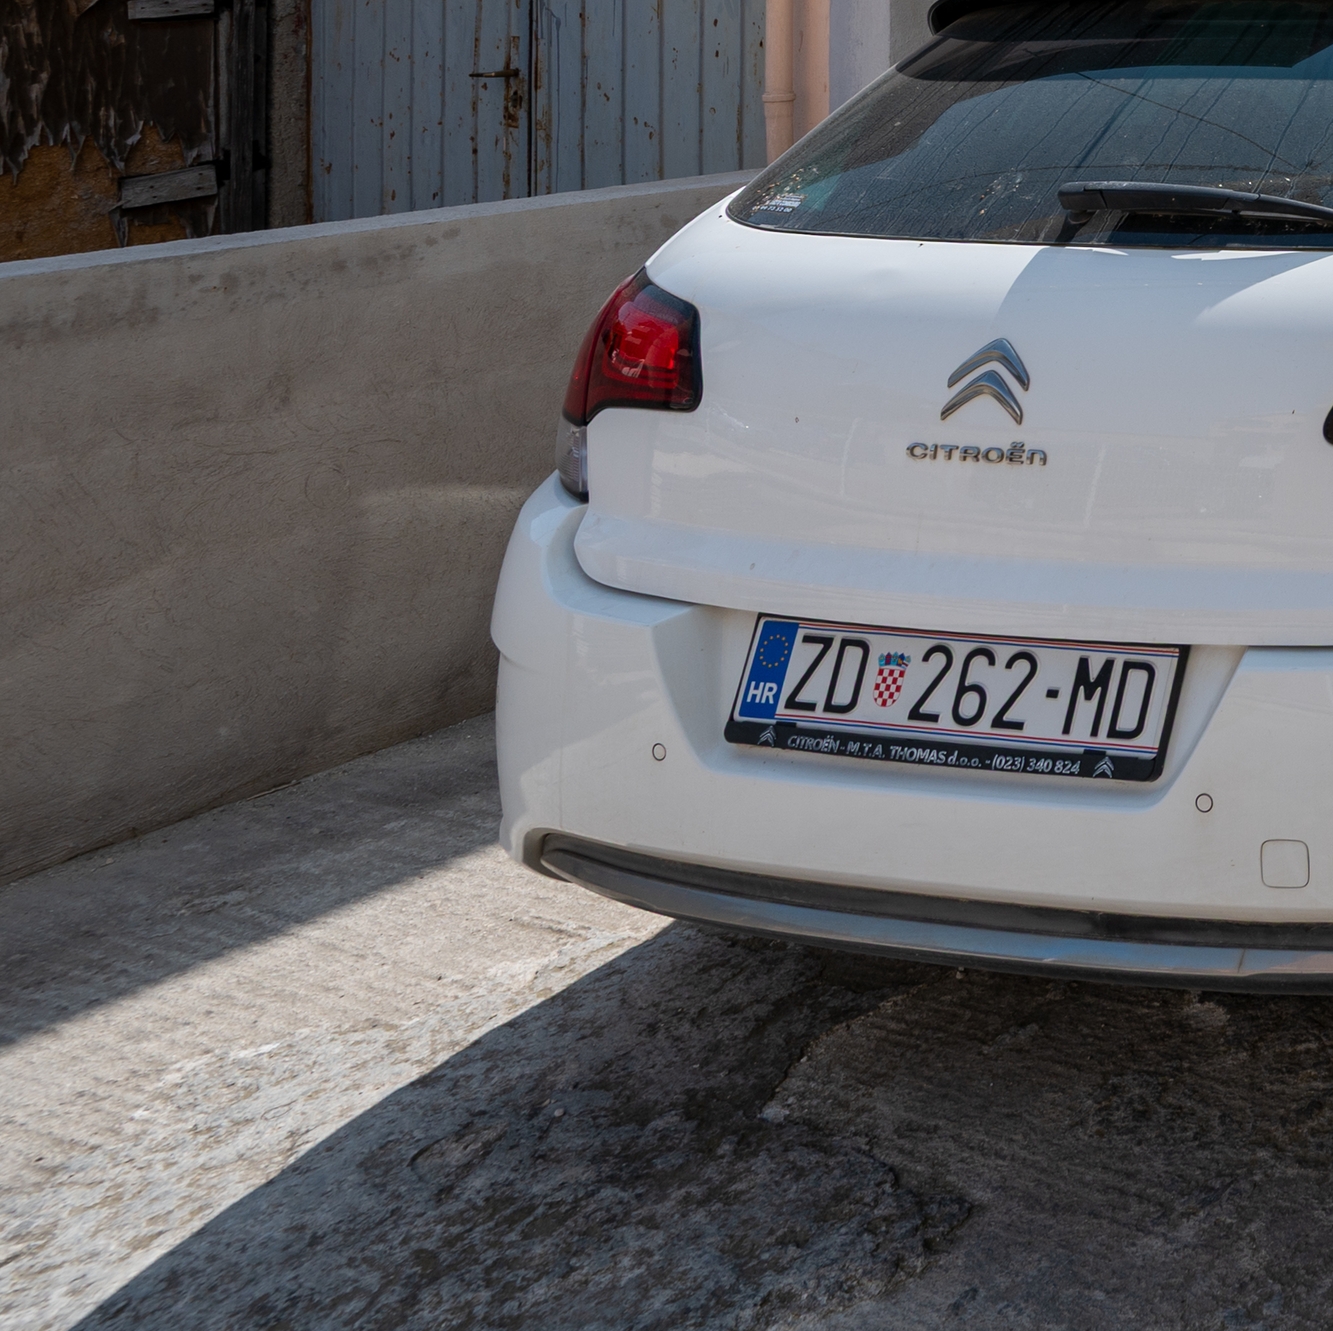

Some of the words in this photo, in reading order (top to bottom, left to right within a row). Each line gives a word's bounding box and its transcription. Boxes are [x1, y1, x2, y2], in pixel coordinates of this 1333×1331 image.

[905, 440, 1048, 467] CITROËN
[746, 681, 776, 705] HR
[783, 633, 871, 715] ZD
[907, 643, 1157, 740] 262-MD
[787, 735, 840, 753] CITROËN
[846, 741, 885, 758] M.T.A.
[890, 745, 947, 764] THOMAS
[947, 750, 982, 767] d.o.o.
[991, 754, 1025, 772] (023)
[1027, 757, 1053, 773] 340
[1053, 760, 1081, 775] 824
